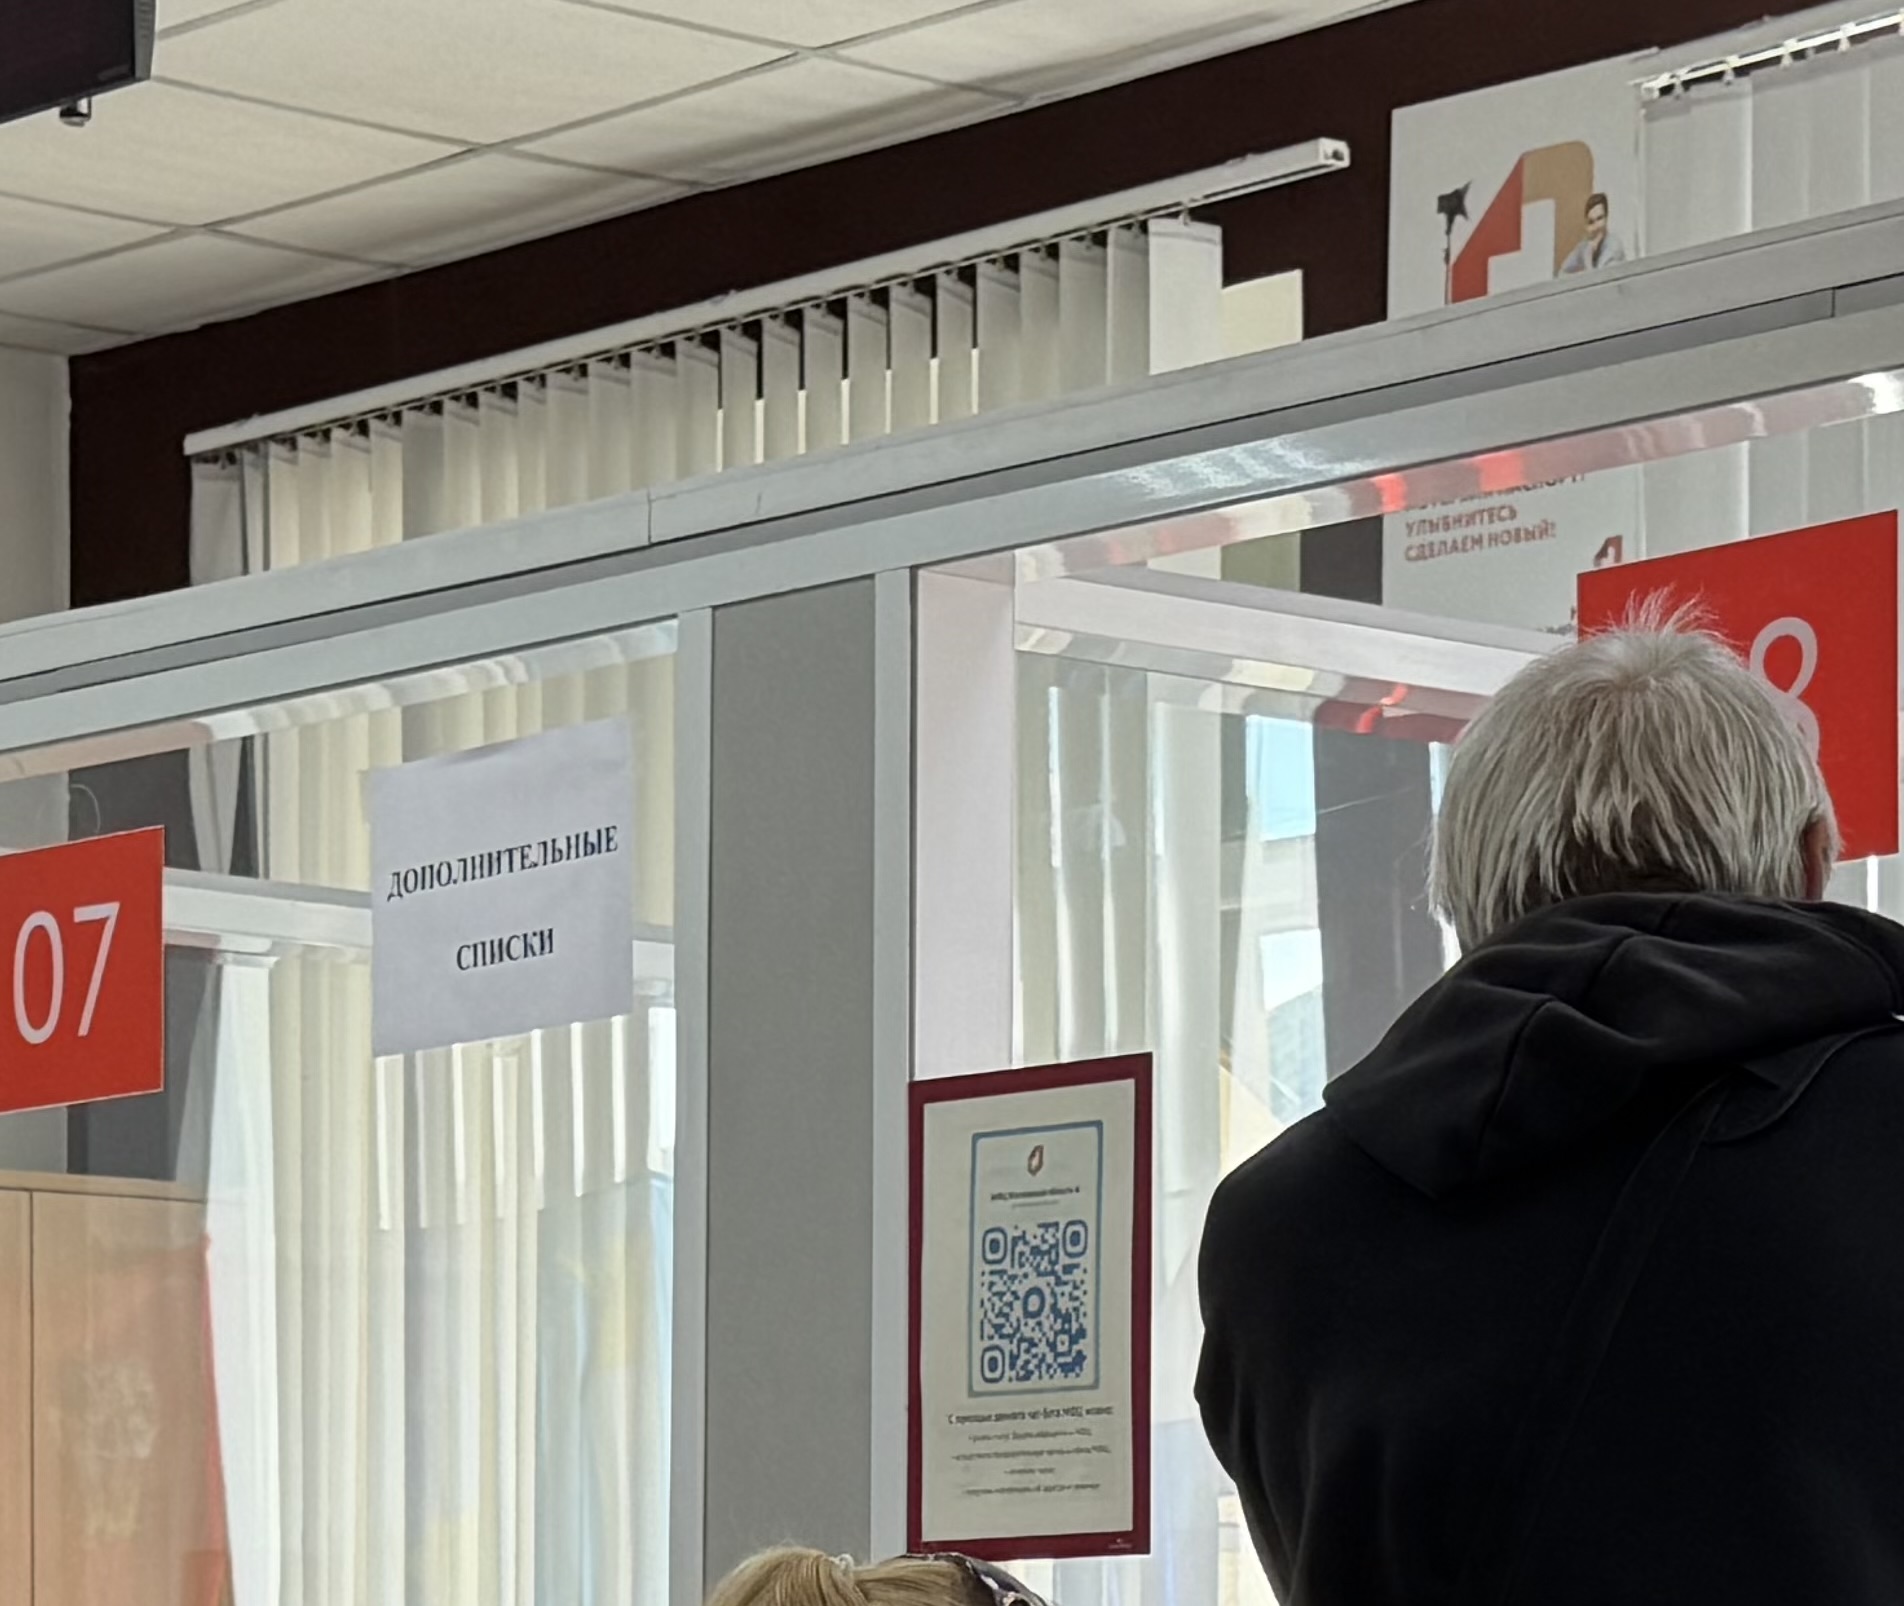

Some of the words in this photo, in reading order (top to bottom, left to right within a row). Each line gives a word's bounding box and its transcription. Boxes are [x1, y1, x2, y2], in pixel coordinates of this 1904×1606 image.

[386, 824, 619, 903] ДОПОЛНИТЕЛЬНЫЕ
[12, 901, 121, 1045] 07
[455, 927, 555, 972] СПИСКИ
